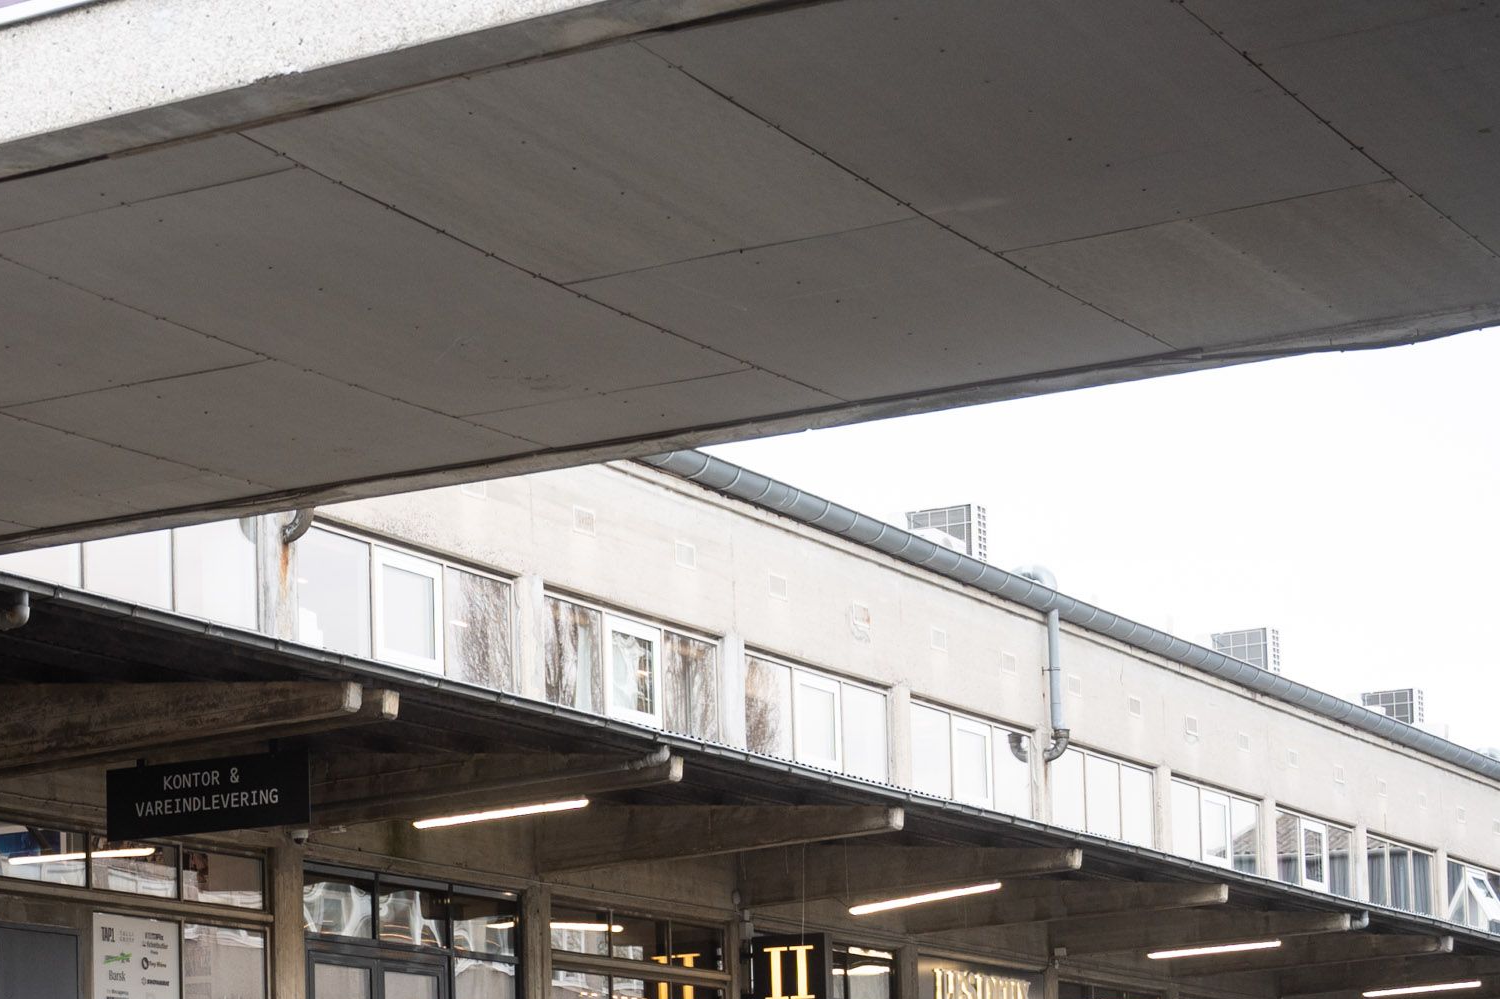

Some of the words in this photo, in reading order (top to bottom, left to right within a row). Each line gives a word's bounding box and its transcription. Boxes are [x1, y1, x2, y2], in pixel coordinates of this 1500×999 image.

[163, 770, 220, 791] KONTOR
[229, 767, 240, 784] &
[135, 788, 279, 818] VAREINDLEVERING
